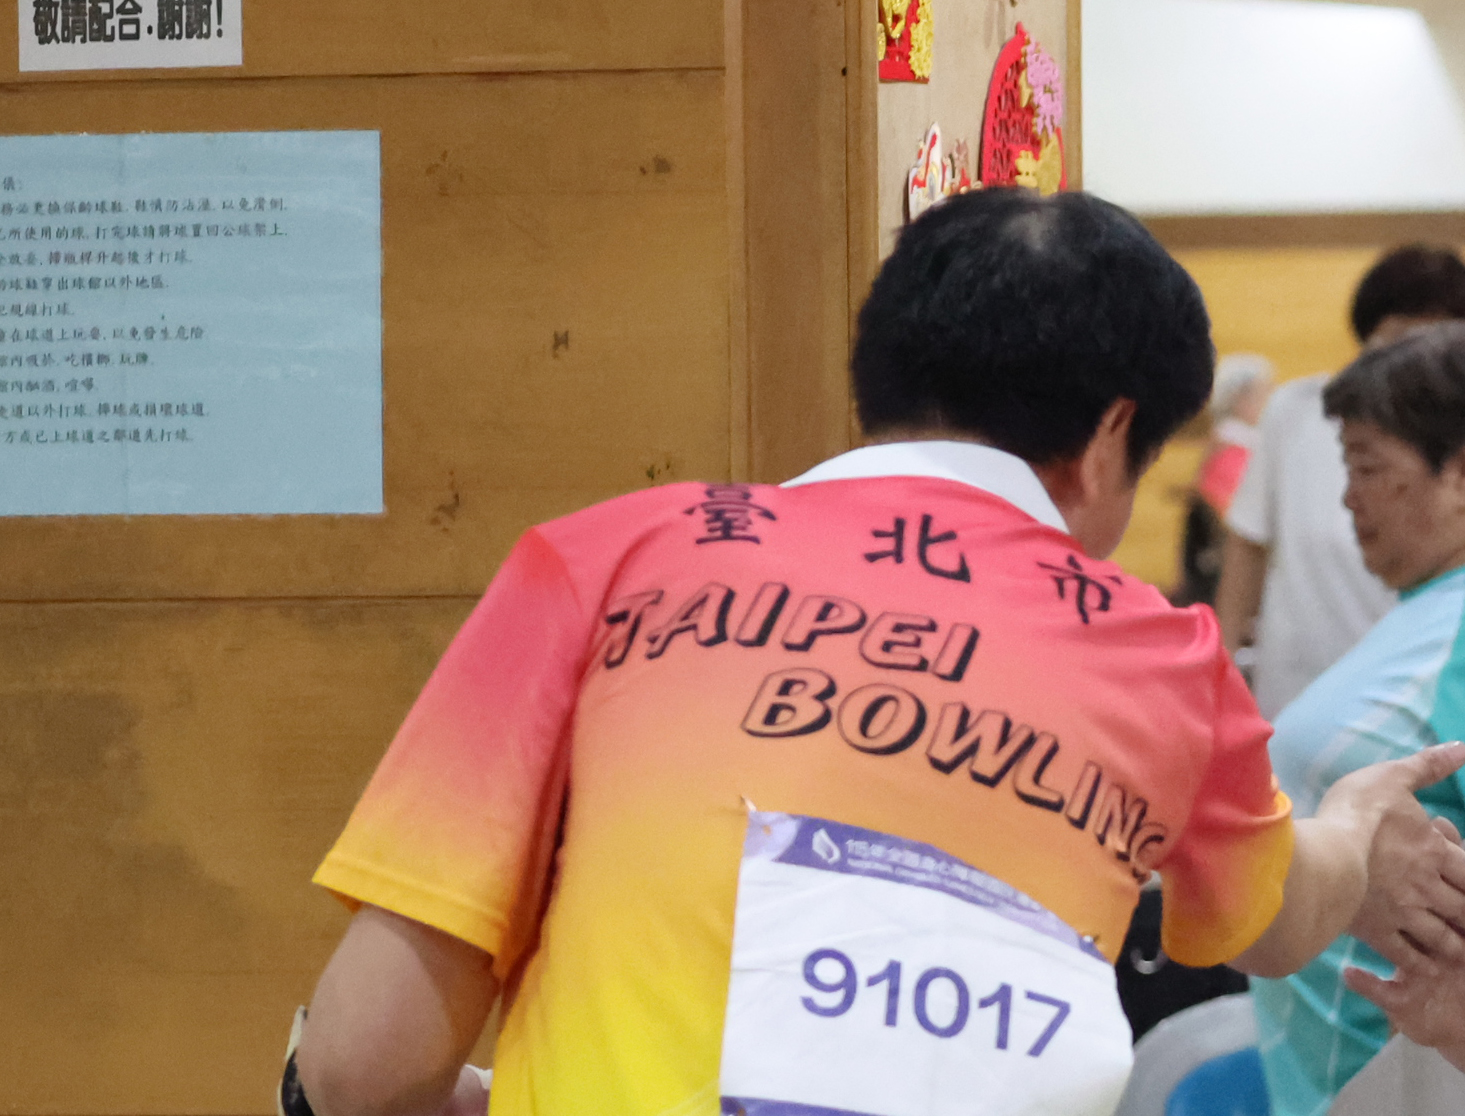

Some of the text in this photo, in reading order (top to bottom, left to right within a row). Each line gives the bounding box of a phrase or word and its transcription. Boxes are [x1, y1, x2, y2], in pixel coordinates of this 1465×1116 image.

[683, 483, 1122, 624] 臺北市
[604, 581, 980, 683] TAIPEI
[800, 947, 1071, 1059] 91017
